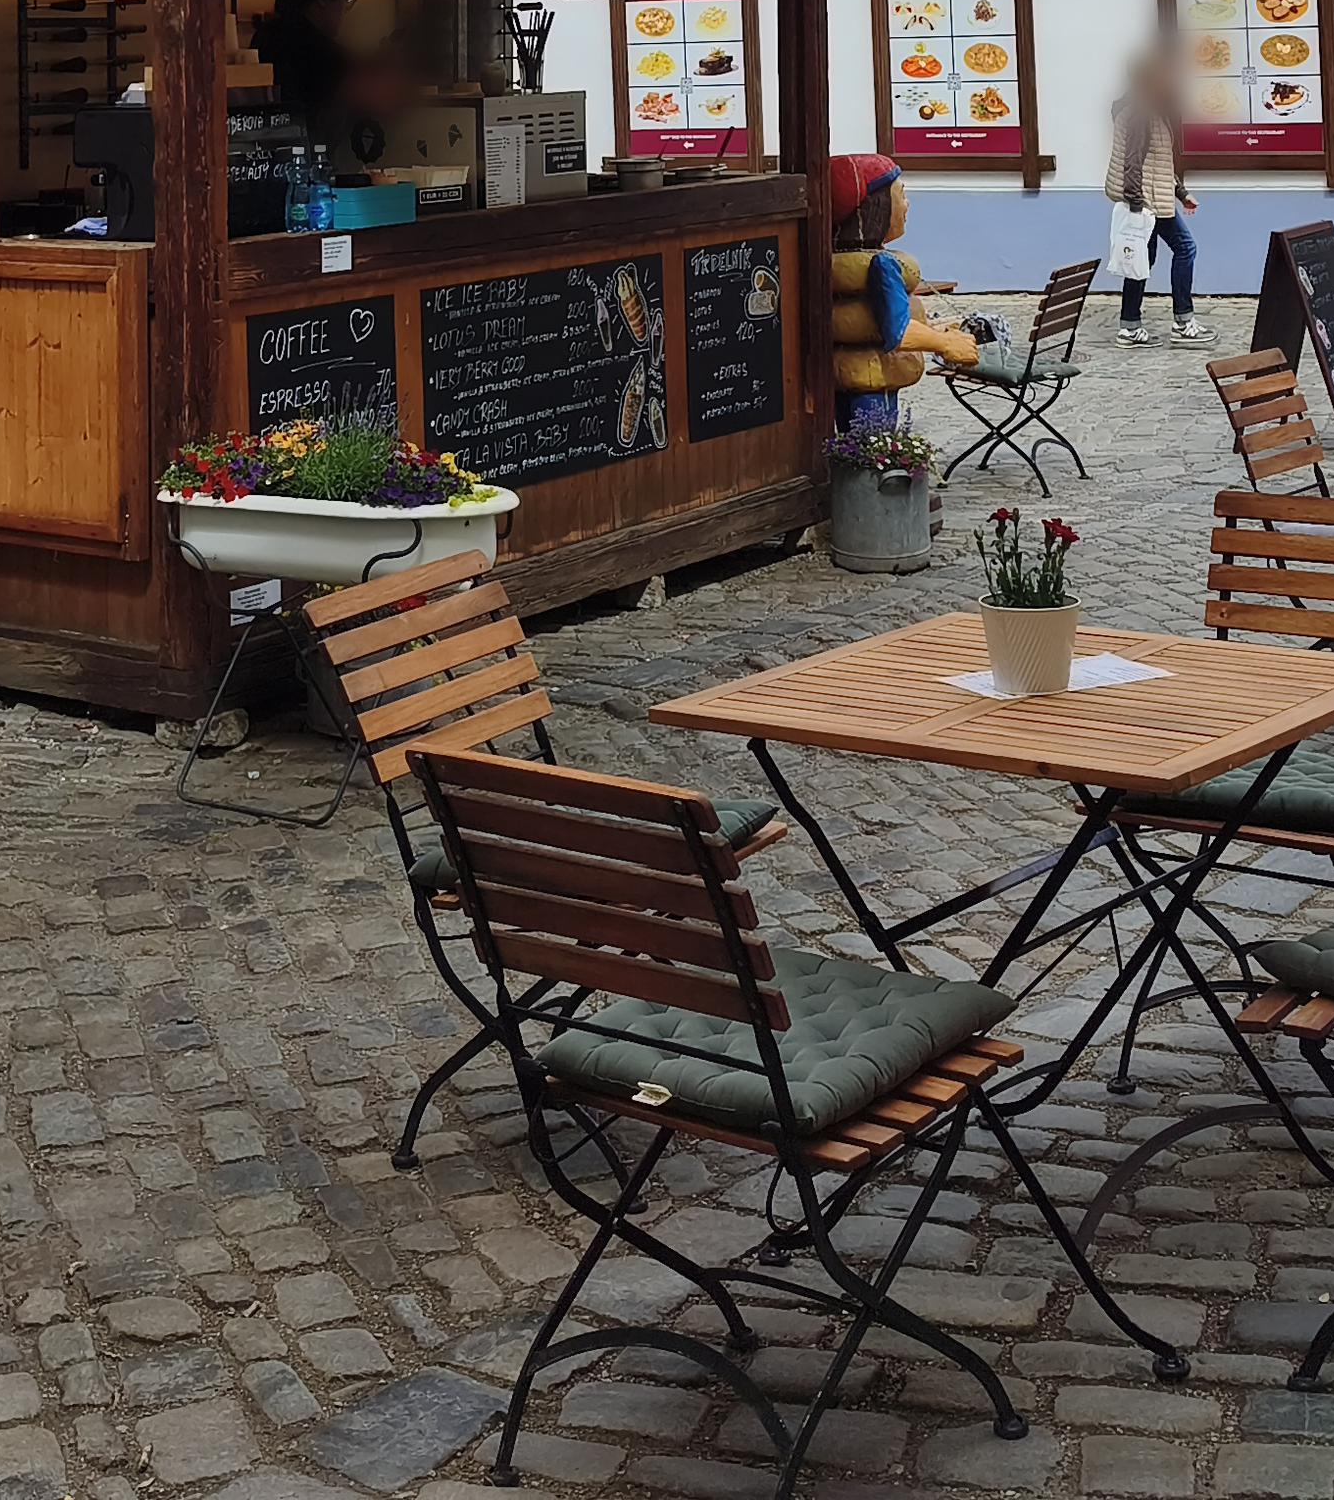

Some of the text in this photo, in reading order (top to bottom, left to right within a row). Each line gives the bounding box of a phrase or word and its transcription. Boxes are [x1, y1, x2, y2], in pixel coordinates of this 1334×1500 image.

[691, 241, 753, 276] TRDELNÍK
[433, 287, 457, 313] ICE
[462, 284, 484, 305] ICE
[259, 319, 331, 365] COFFEE
[433, 323, 476, 351] LOTUS
[501, 355, 527, 375] GOOD
[259, 379, 331, 415] ESPRESSO
[434, 407, 471, 436] CANDY
[472, 399, 508, 424] CRASH
[474, 444, 491, 465] LA
